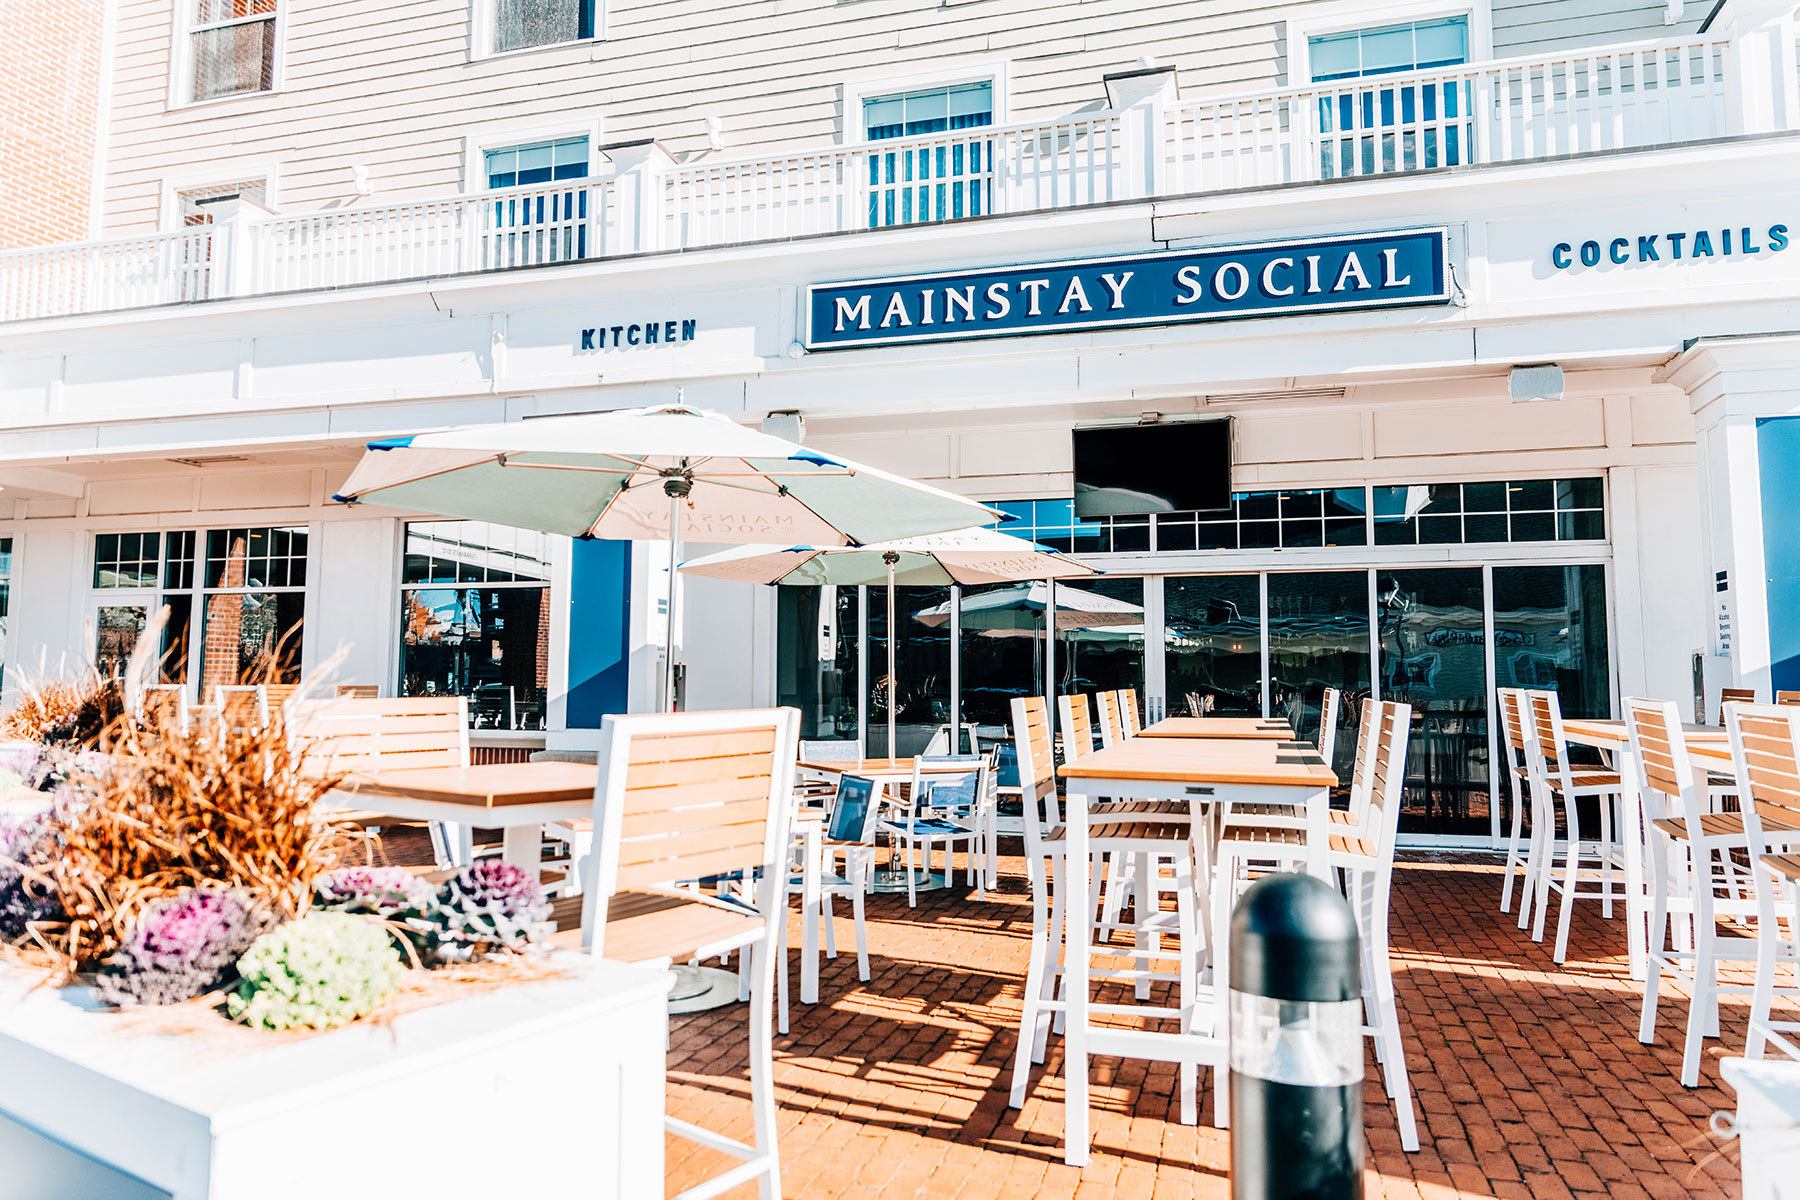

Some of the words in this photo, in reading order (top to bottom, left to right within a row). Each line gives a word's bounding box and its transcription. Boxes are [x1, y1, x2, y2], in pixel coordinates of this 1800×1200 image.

[1553, 224, 1789, 269] COCKTAILS
[834, 271, 1134, 331] MAINSTAY
[1177, 248, 1411, 304] SOCIAL
[581, 319, 696, 350] KITCHEN
